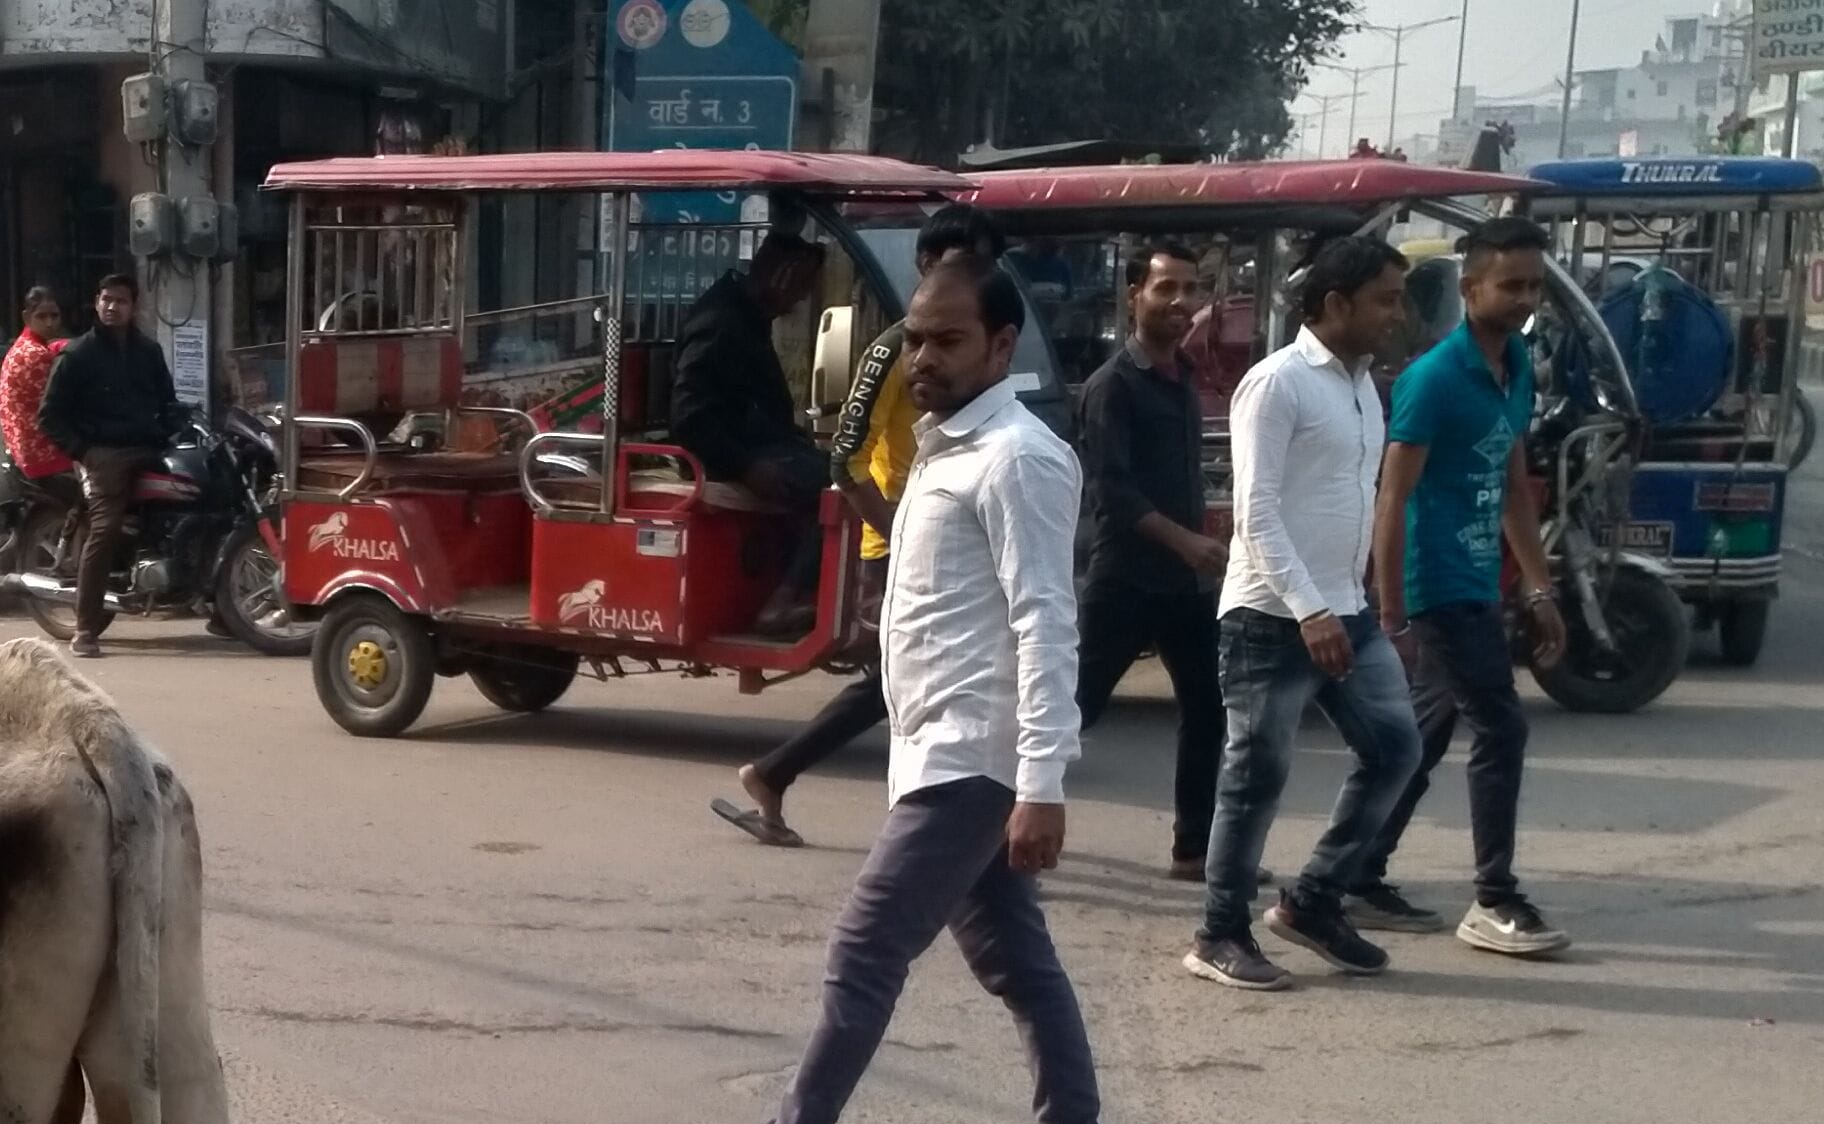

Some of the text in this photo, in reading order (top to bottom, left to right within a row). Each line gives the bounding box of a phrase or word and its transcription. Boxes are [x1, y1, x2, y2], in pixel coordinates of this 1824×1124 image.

[648, 89, 691, 123] वार्ड
[737, 100, 752, 123] 3
[1621, 162, 1722, 183] THUKRAL
[332, 536, 400, 562] KHALSA
[587, 607, 664, 633] KHALSA
